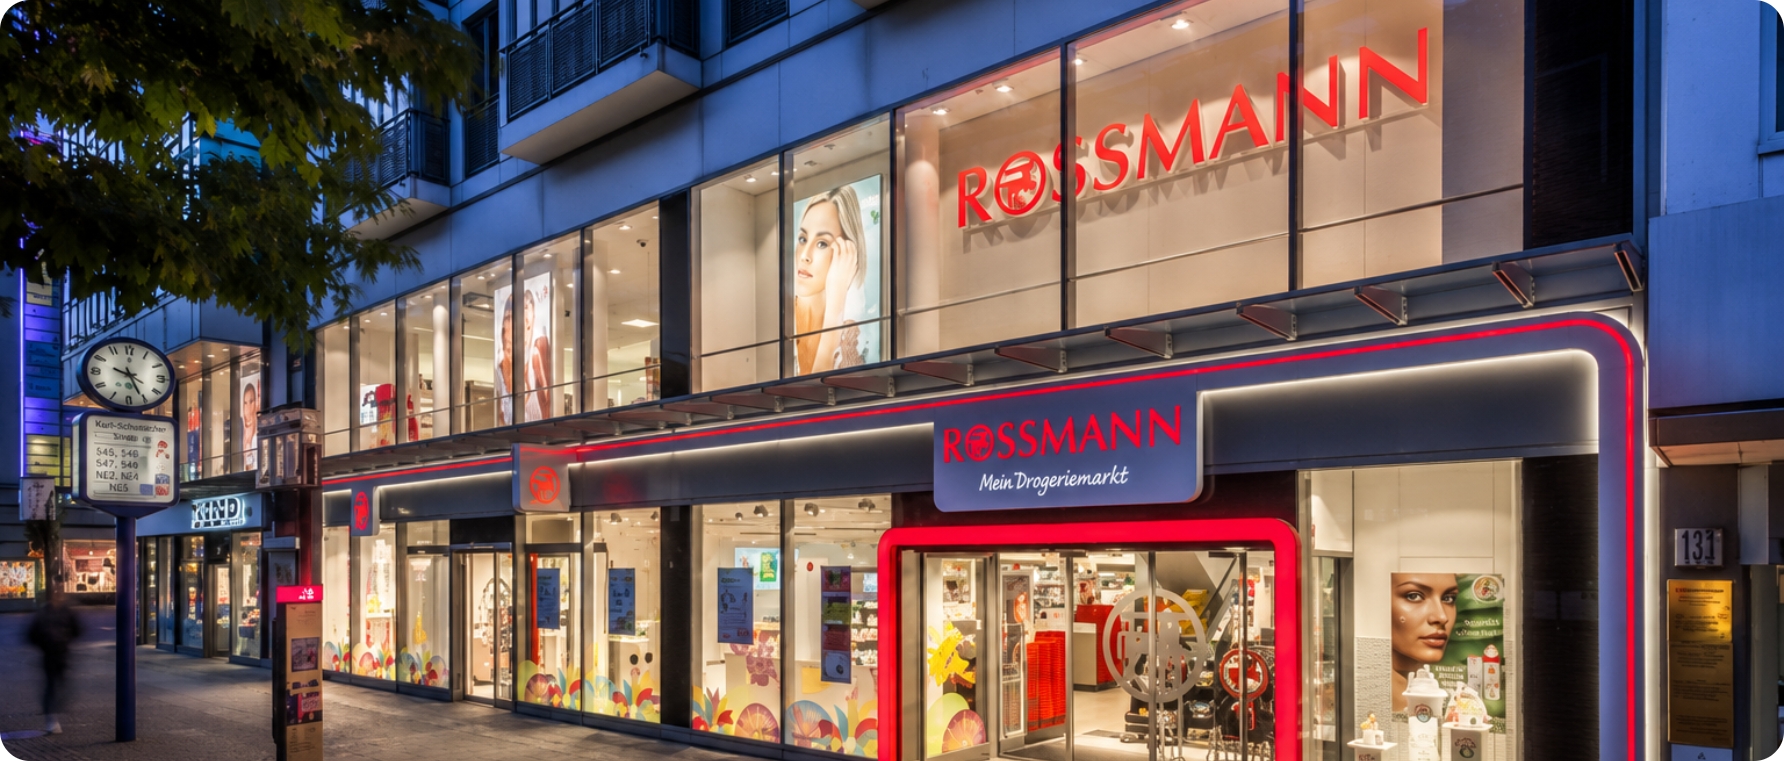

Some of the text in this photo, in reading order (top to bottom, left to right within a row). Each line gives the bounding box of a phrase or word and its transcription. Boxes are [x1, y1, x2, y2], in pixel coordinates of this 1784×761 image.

[957, 27, 1428, 228] ROSSMANN
[942, 404, 1181, 463] ROSSMANN
[979, 465, 1129, 496] Mein Drogeriemarkt
